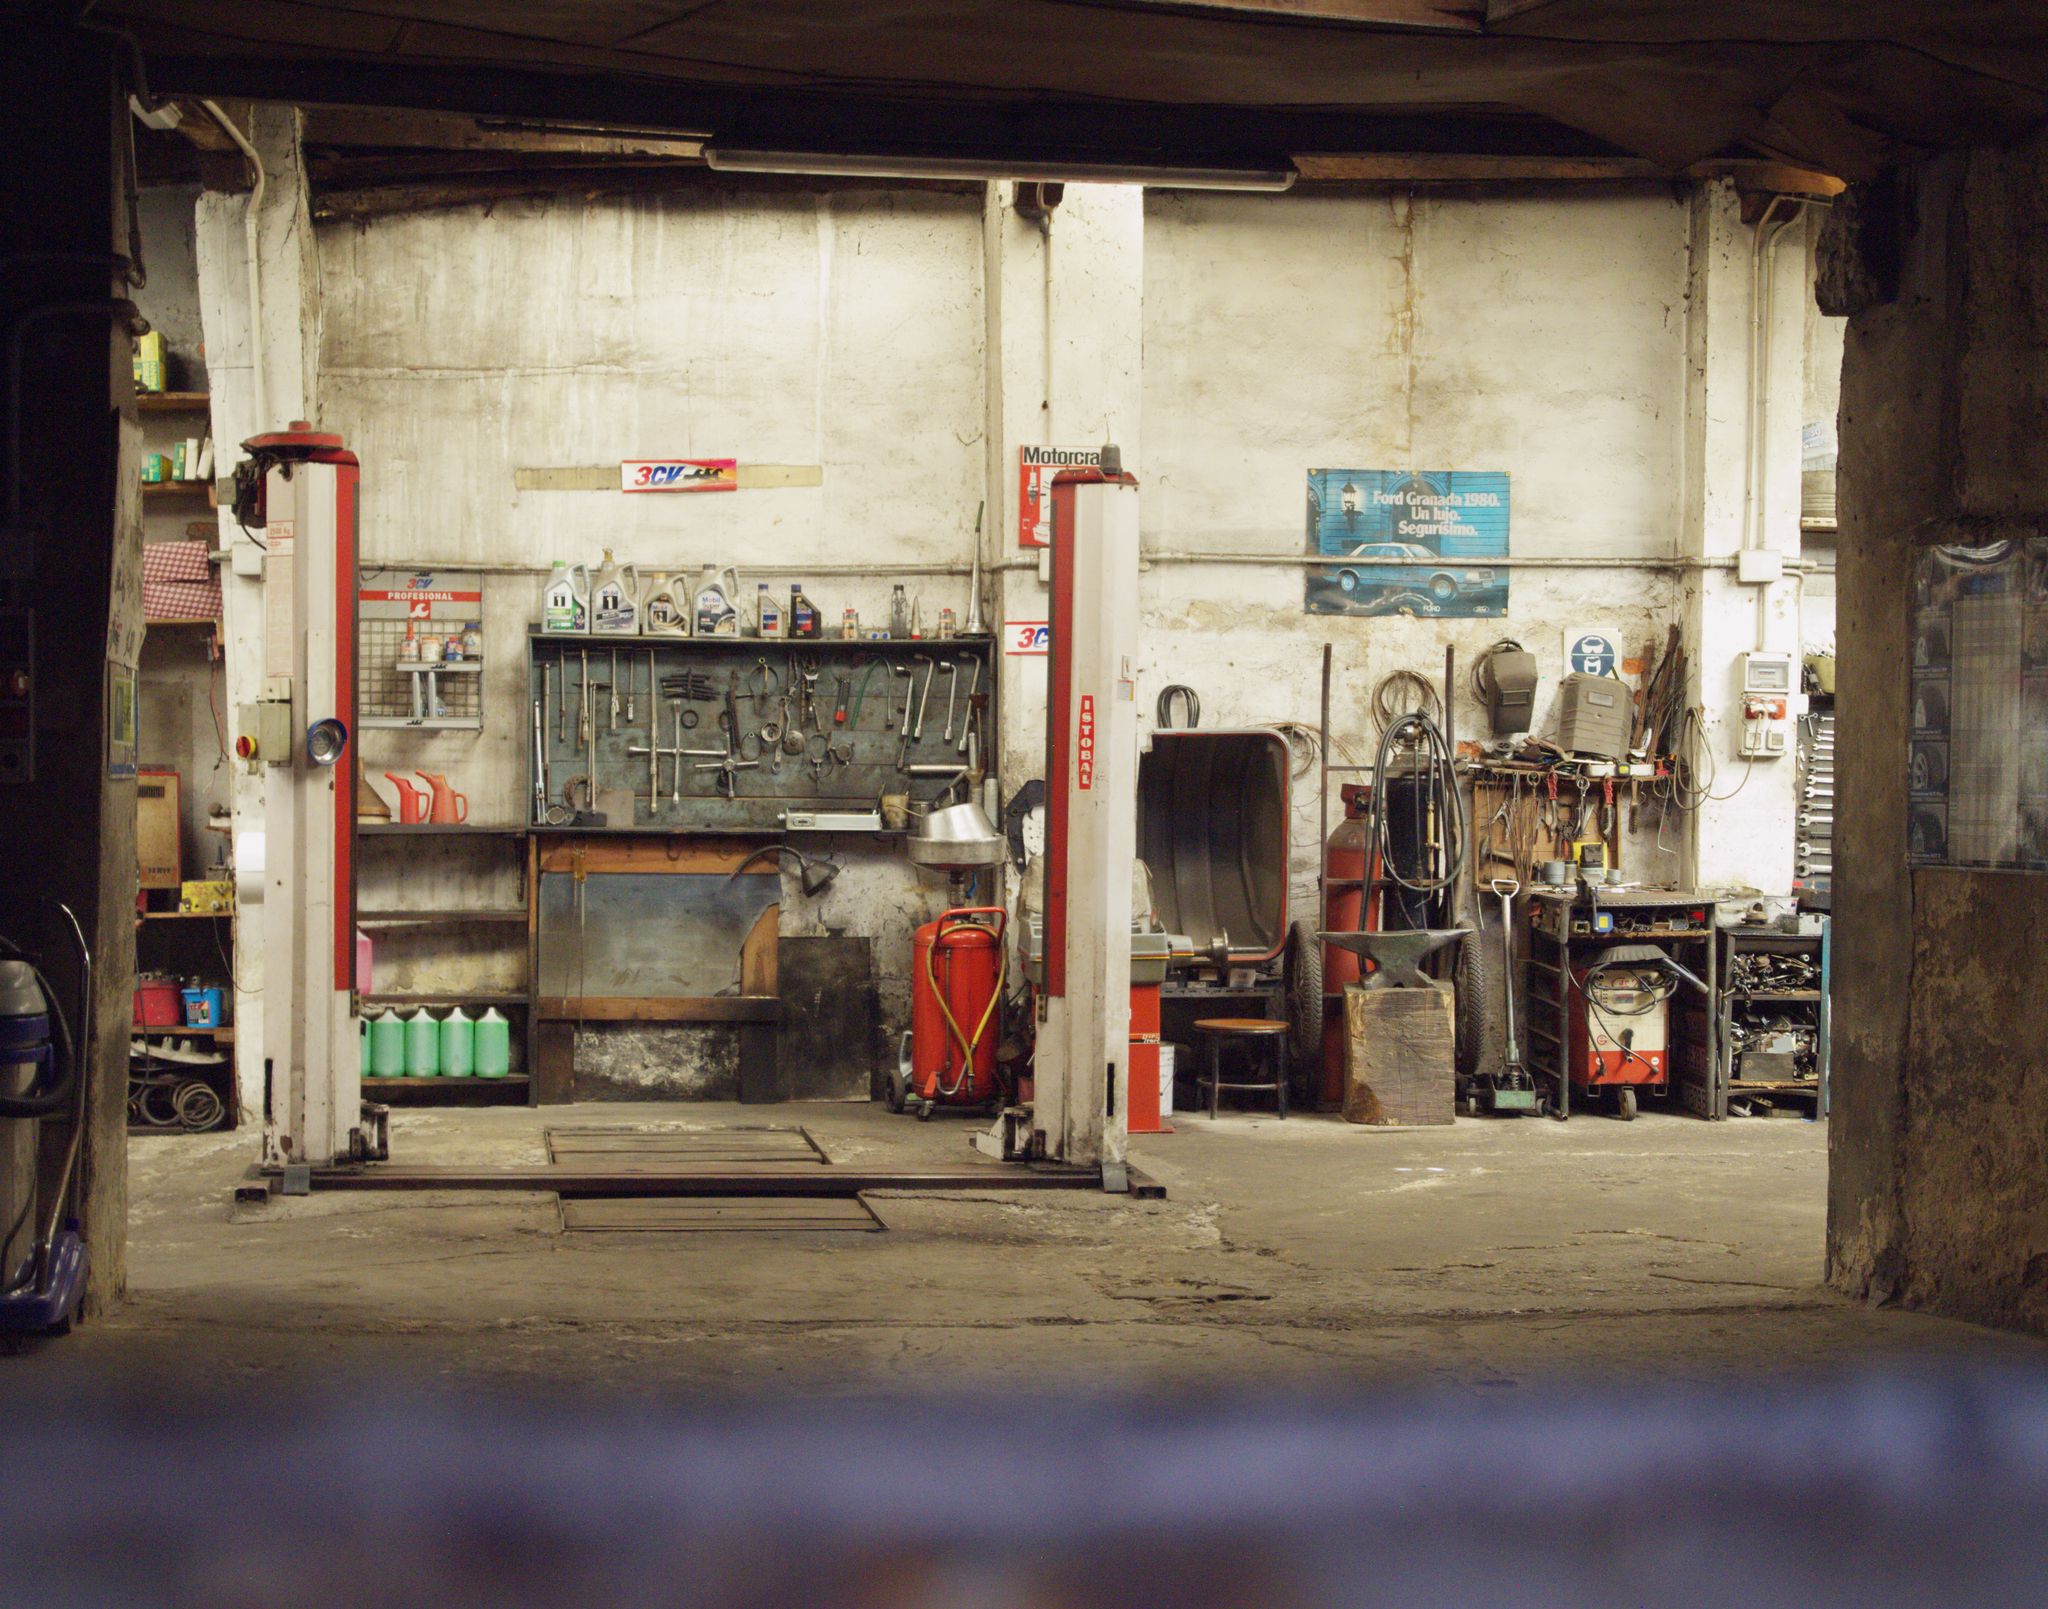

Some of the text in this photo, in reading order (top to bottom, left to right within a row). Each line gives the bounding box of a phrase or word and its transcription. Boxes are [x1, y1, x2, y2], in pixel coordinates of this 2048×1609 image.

[1024, 446, 1100, 465] Motorcra
[634, 465, 686, 486] 3CV
[1373, 491, 1500, 507] Ford Granada 1980.
[1411, 507, 1461, 524] Un lujo.
[406, 578, 434, 589] 3CV
[388, 592, 453, 600] PROFESIONAL
[1423, 605, 1440, 613] FORD
[1017, 627, 1049, 648] 3C
[1080, 700, 1092, 785] ISTOBAL
